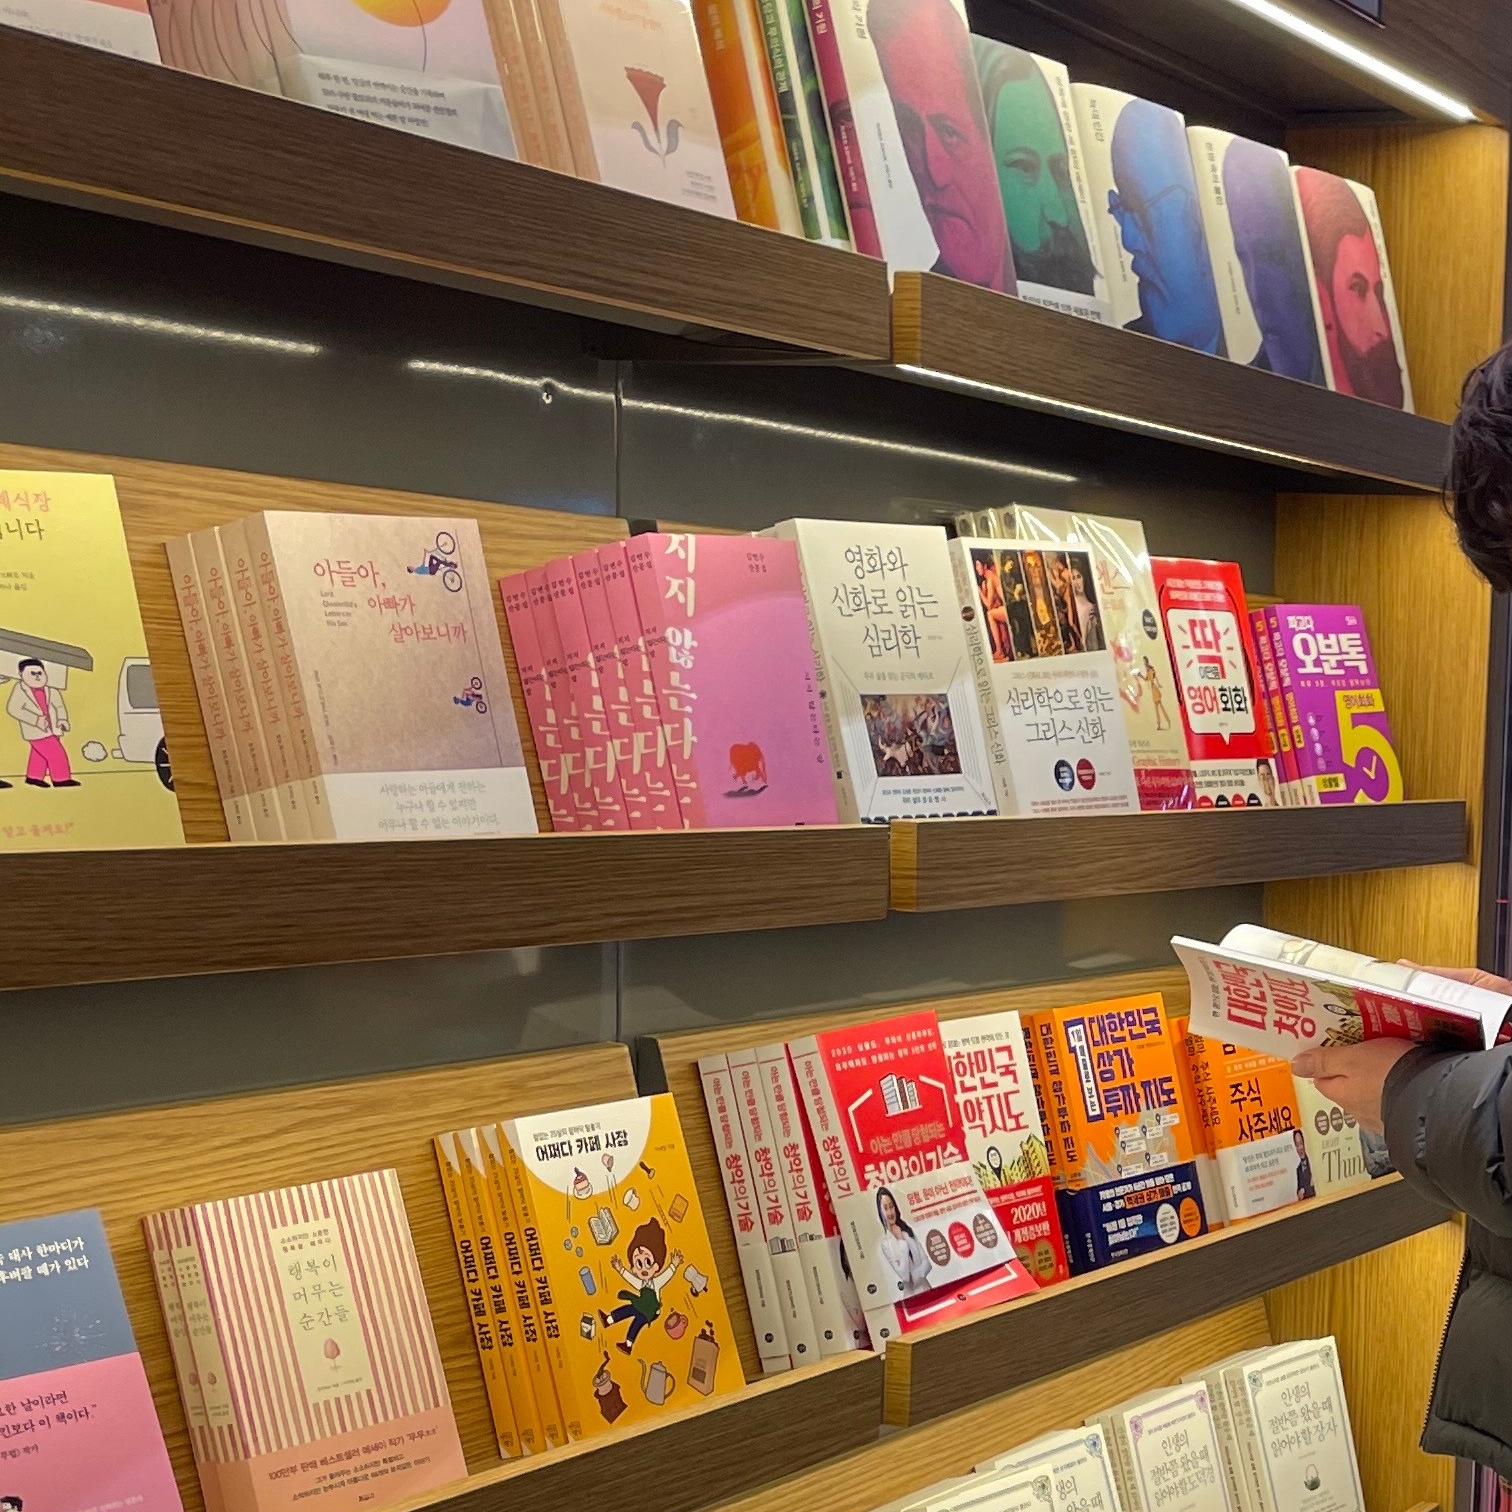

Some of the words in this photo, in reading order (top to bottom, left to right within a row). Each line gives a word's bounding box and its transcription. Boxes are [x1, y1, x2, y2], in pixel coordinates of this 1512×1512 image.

[0, 519, 45, 541] 니다
[313, 558, 387, 590] 아들아,
[845, 545, 908, 581] 영화와
[367, 594, 416, 616] 아빠가
[832, 583, 893, 619] 신화로
[896, 585, 938, 620] 읽는
[389, 622, 467, 645] 살아보니까
[862, 623, 921, 659] 심리학
[1293, 633, 1368, 675] 오분톡
[1007, 686, 1084, 716] 심리학으로
[1084, 685, 1114, 713] 읽는
[1025, 718, 1075, 746] 그리스
[1077, 716, 1106, 746] 신화
[1087, 1006, 1163, 1047] 대한민국
[947, 1044, 1019, 1094] 한민국
[1097, 1047, 1135, 1083] 상가
[1102, 1082, 1141, 1118] 투자
[1140, 1076, 1178, 1111] 지도
[1229, 1078, 1263, 1112] 주식
[1238, 1106, 1296, 1142] 사주세요
[575, 1134, 602, 1154] 카페
[605, 1129, 629, 1149] 사장
[1010, 1201, 1048, 1226] 2020년
[8, 1246, 33, 1264] 대사
[36, 1236, 85, 1259] 한마디가
[64, 1254, 90, 1273] 있다
[287, 1253, 338, 1281] 행복이
[292, 1281, 344, 1305] 머무는
[300, 1304, 350, 1331] 순간들
[21, 1390, 69, 1412] 날이라면
[1280, 1381, 1311, 1407] 인생의
[38, 1415, 52, 1429] 이
[1268, 1409, 1299, 1435] 절반쯤
[1313, 1416, 1339, 1443] 장자
[319, 1448, 361, 1467] 베스트셀러
